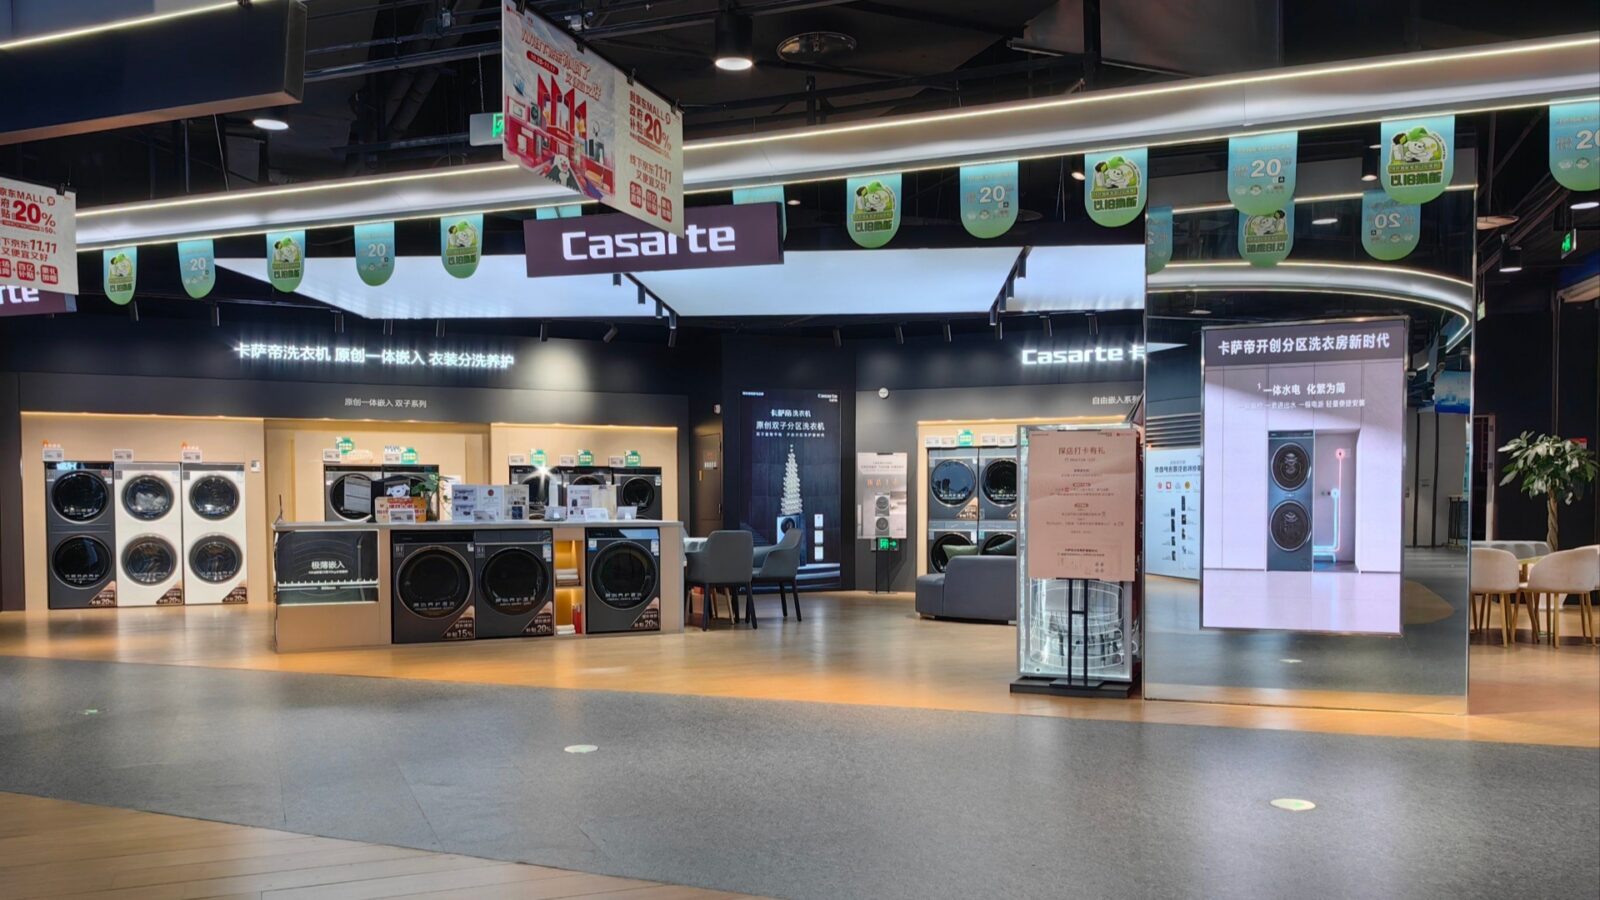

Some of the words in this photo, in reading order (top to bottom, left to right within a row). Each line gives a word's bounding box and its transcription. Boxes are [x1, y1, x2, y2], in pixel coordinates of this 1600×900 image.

[645, 113, 671, 152] 20%
[1251, 158, 1281, 178] 20
[1391, 172, 1441, 186] 以旧换新
[980, 185, 1005, 203] 20
[13, 200, 56, 228] 20%
[368, 243, 386, 257] 20
[562, 224, 736, 261] Casarte
[2, 246, 48, 262] 又便宜又好
[190, 257, 206, 271] 20
[1218, 333, 1390, 356] 卡萨帝开创分区洗衣房新时代
[234, 343, 330, 362] 卡萨帝洗衣机
[335, 347, 425, 366] 原创一体嵌入
[429, 351, 514, 369] 衣装分洗养护
[1022, 347, 1123, 365] Casarte
[1263, 384, 1300, 396] 一体水电
[1307, 382, 1346, 395] 化繁为简
[344, 398, 394, 408] 原创一体嵌入
[395, 399, 427, 408] 双子系列
[756, 421, 825, 430] 原创双子分区洗衣机
[311, 560, 345, 570] 极薄嵌入
